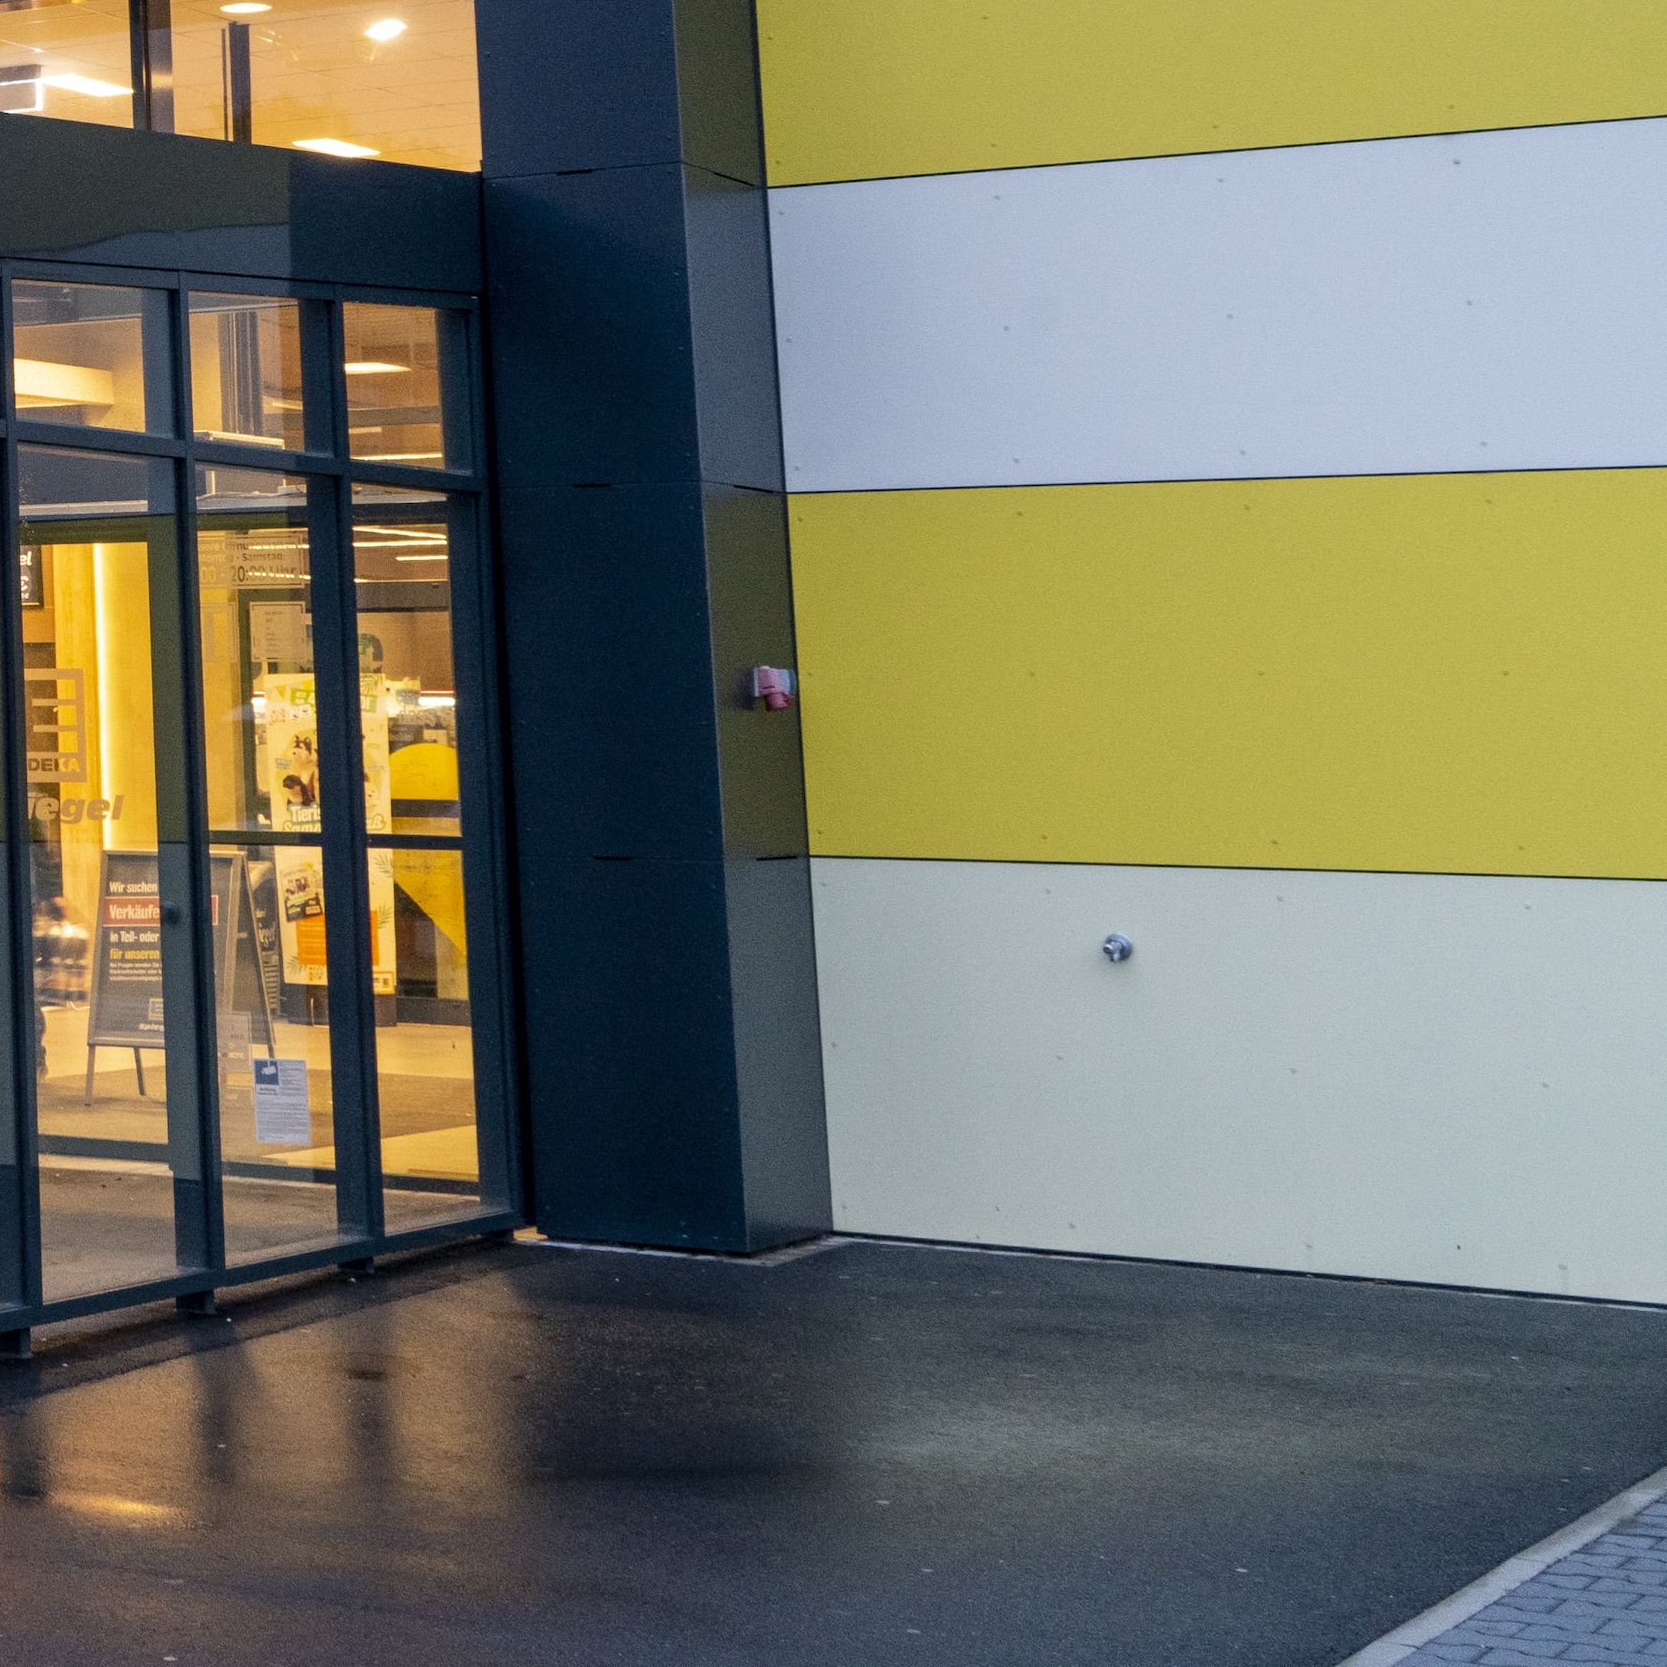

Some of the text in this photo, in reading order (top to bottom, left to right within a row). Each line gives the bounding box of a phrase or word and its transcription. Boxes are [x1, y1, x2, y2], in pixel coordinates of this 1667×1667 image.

[27, 757, 81, 773] DEKA
[109, 882, 158, 894] Wir suchen
[110, 931, 160, 943] in Teil- oder
[109, 948, 160, 960] für unseren
